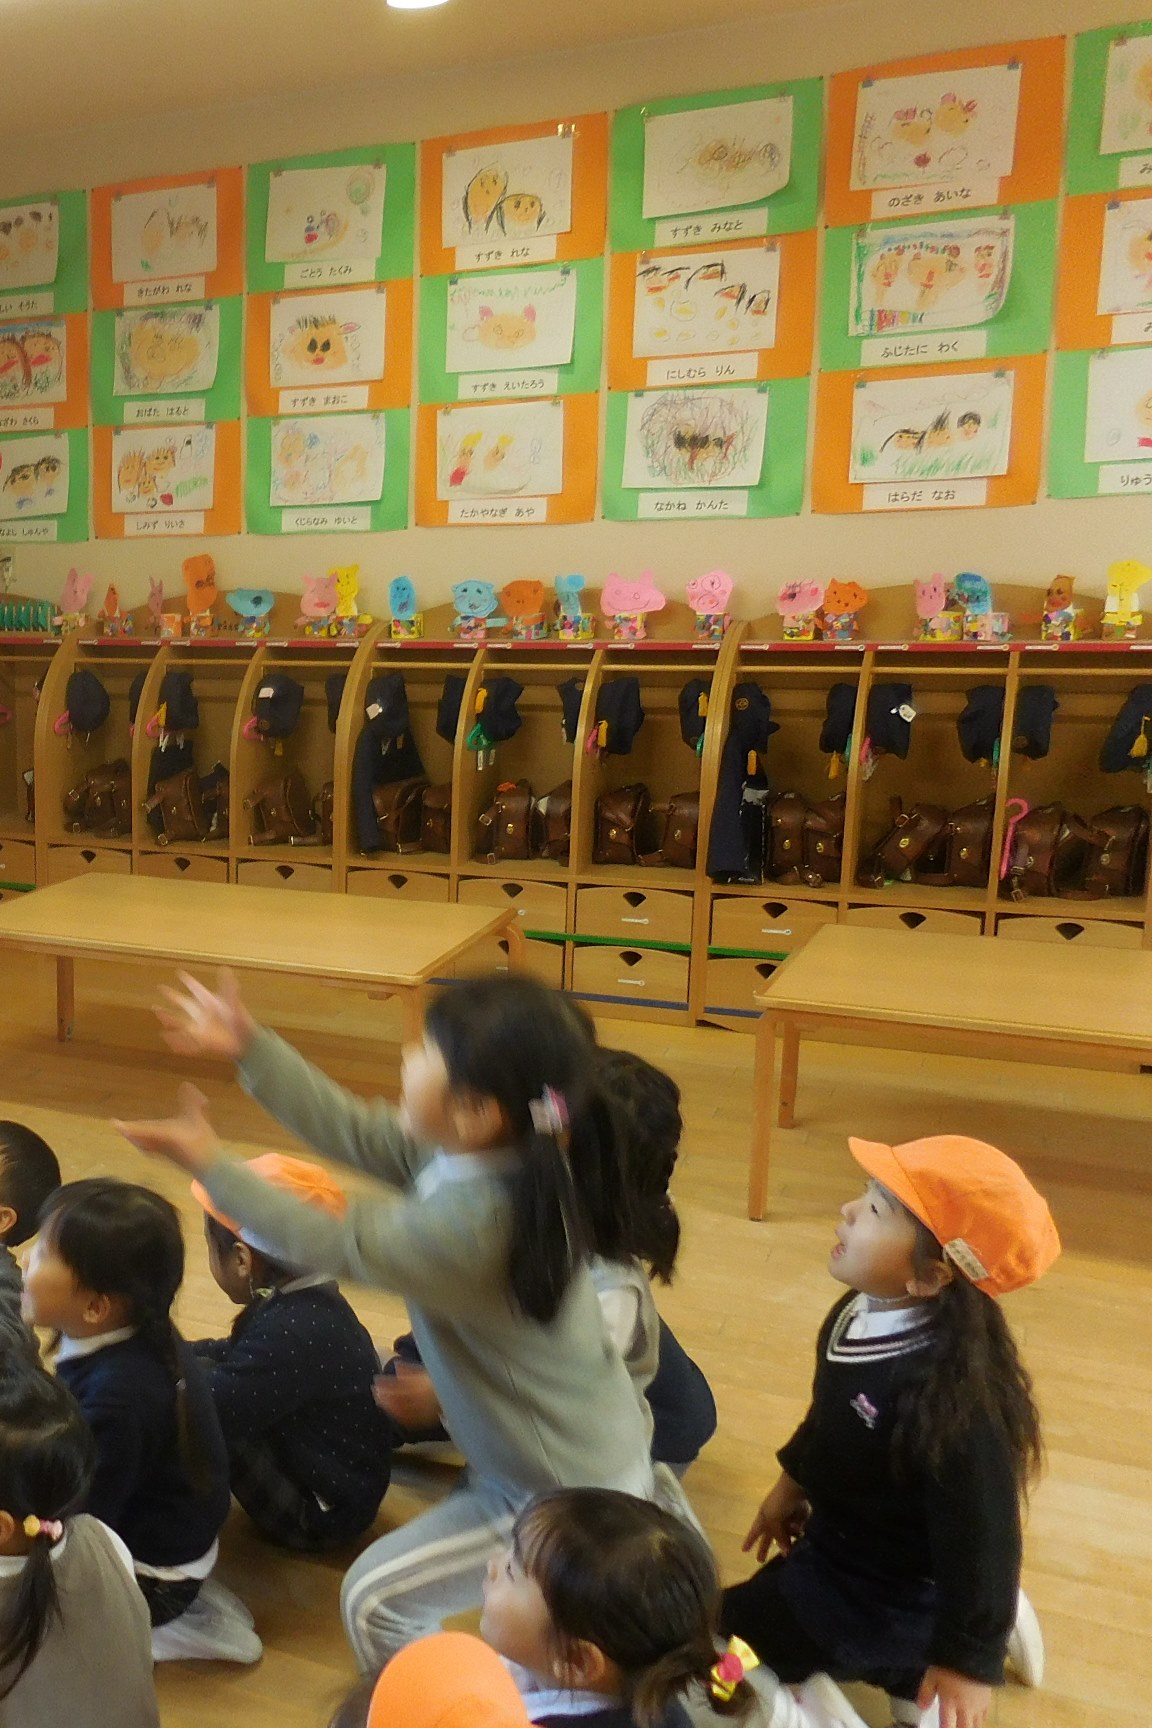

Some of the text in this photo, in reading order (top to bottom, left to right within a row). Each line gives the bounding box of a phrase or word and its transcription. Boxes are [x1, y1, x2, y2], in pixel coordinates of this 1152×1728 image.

[888, 188, 971, 207] のざき あいな
[670, 220, 744, 238] すずき みなと
[475, 250, 502, 263] すずき
[881, 340, 959, 358] ふじたに わく
[666, 364, 735, 380] にしむら りん
[472, 379, 544, 393] すずき えいたろう
[291, 396, 316, 408] すずき
[888, 489, 956, 503] はらだ なお
[460, 507, 534, 518] たかやなぎ あや
[654, 499, 728, 512] なかね かんた
